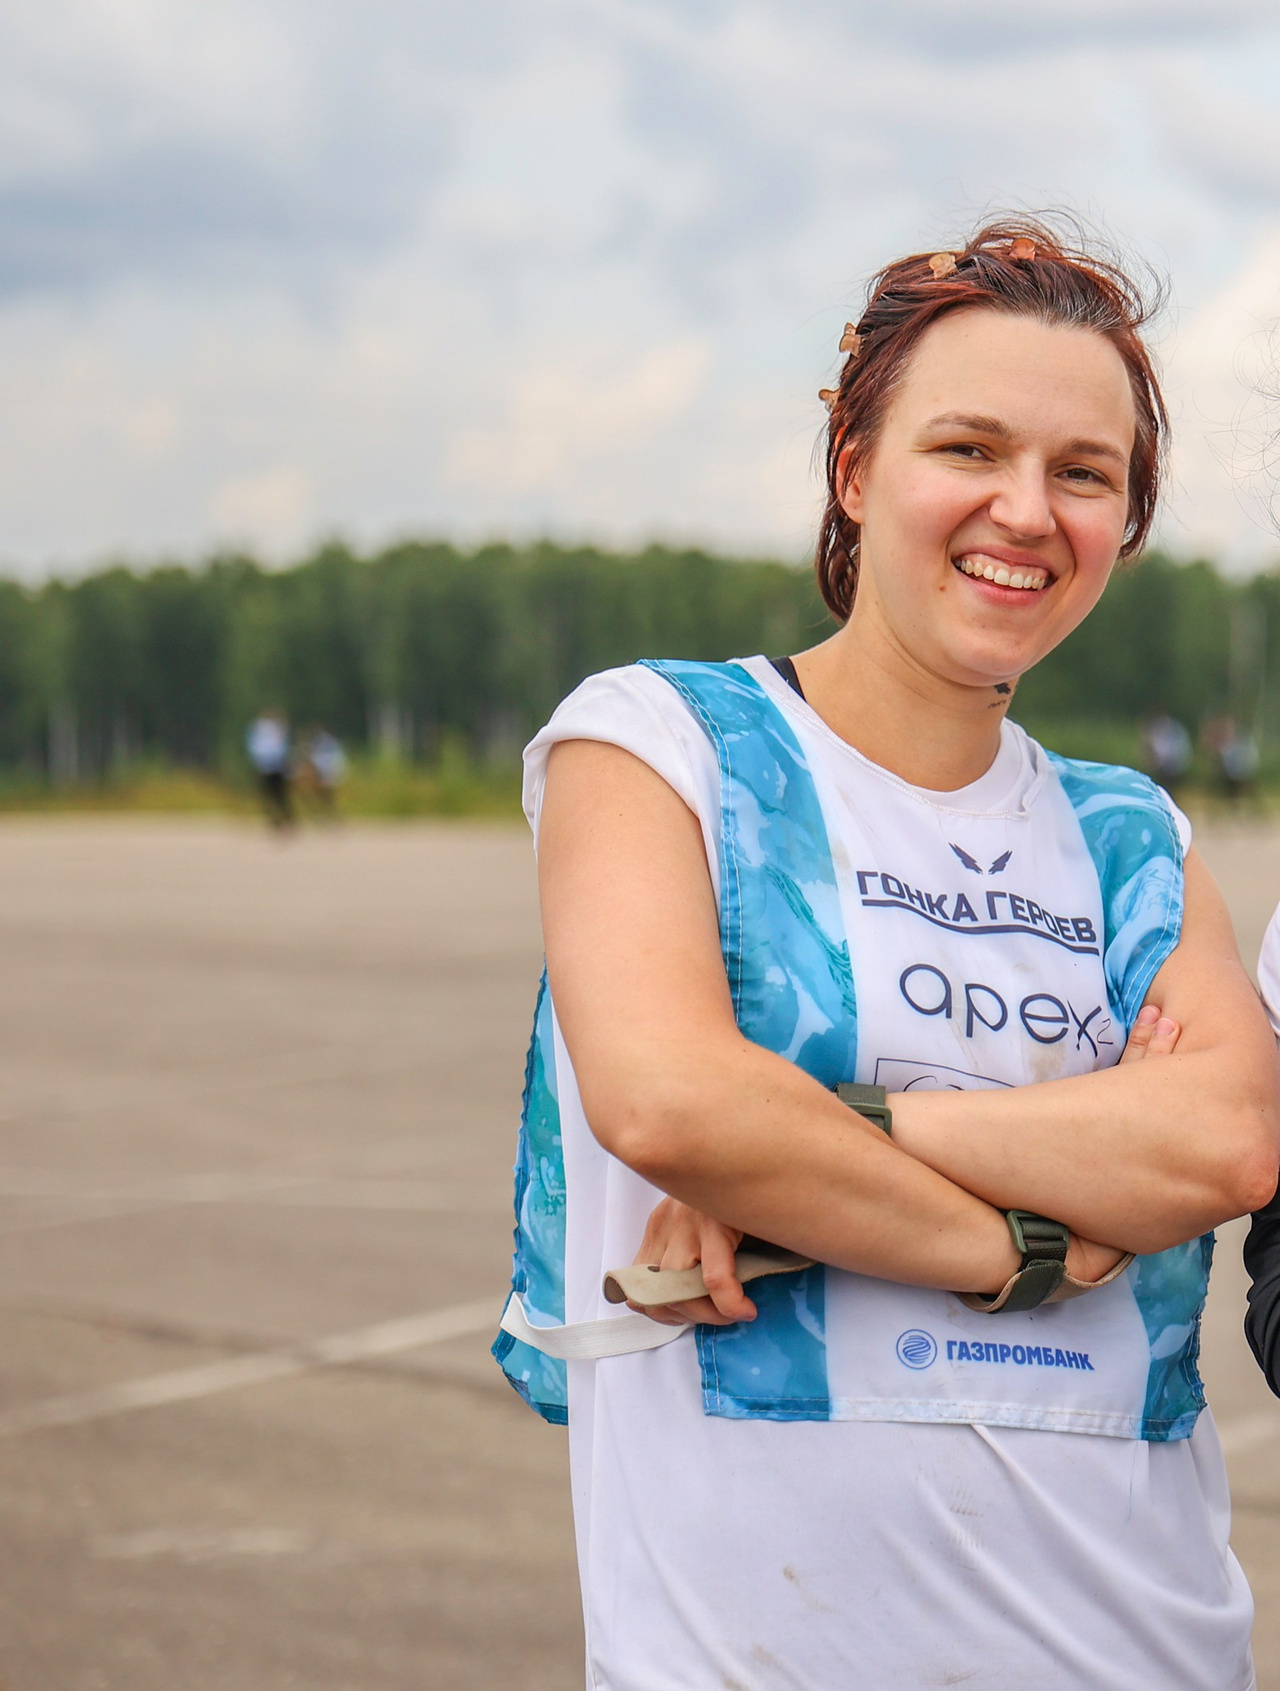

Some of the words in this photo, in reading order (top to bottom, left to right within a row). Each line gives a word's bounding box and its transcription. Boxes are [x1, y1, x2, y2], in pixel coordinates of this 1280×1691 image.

[856, 870, 979, 922] ГОНКА
[985, 890, 1097, 943] ГЕРОЕВ
[946, 1339, 1095, 1371] ГАЗПРОМБАНК
